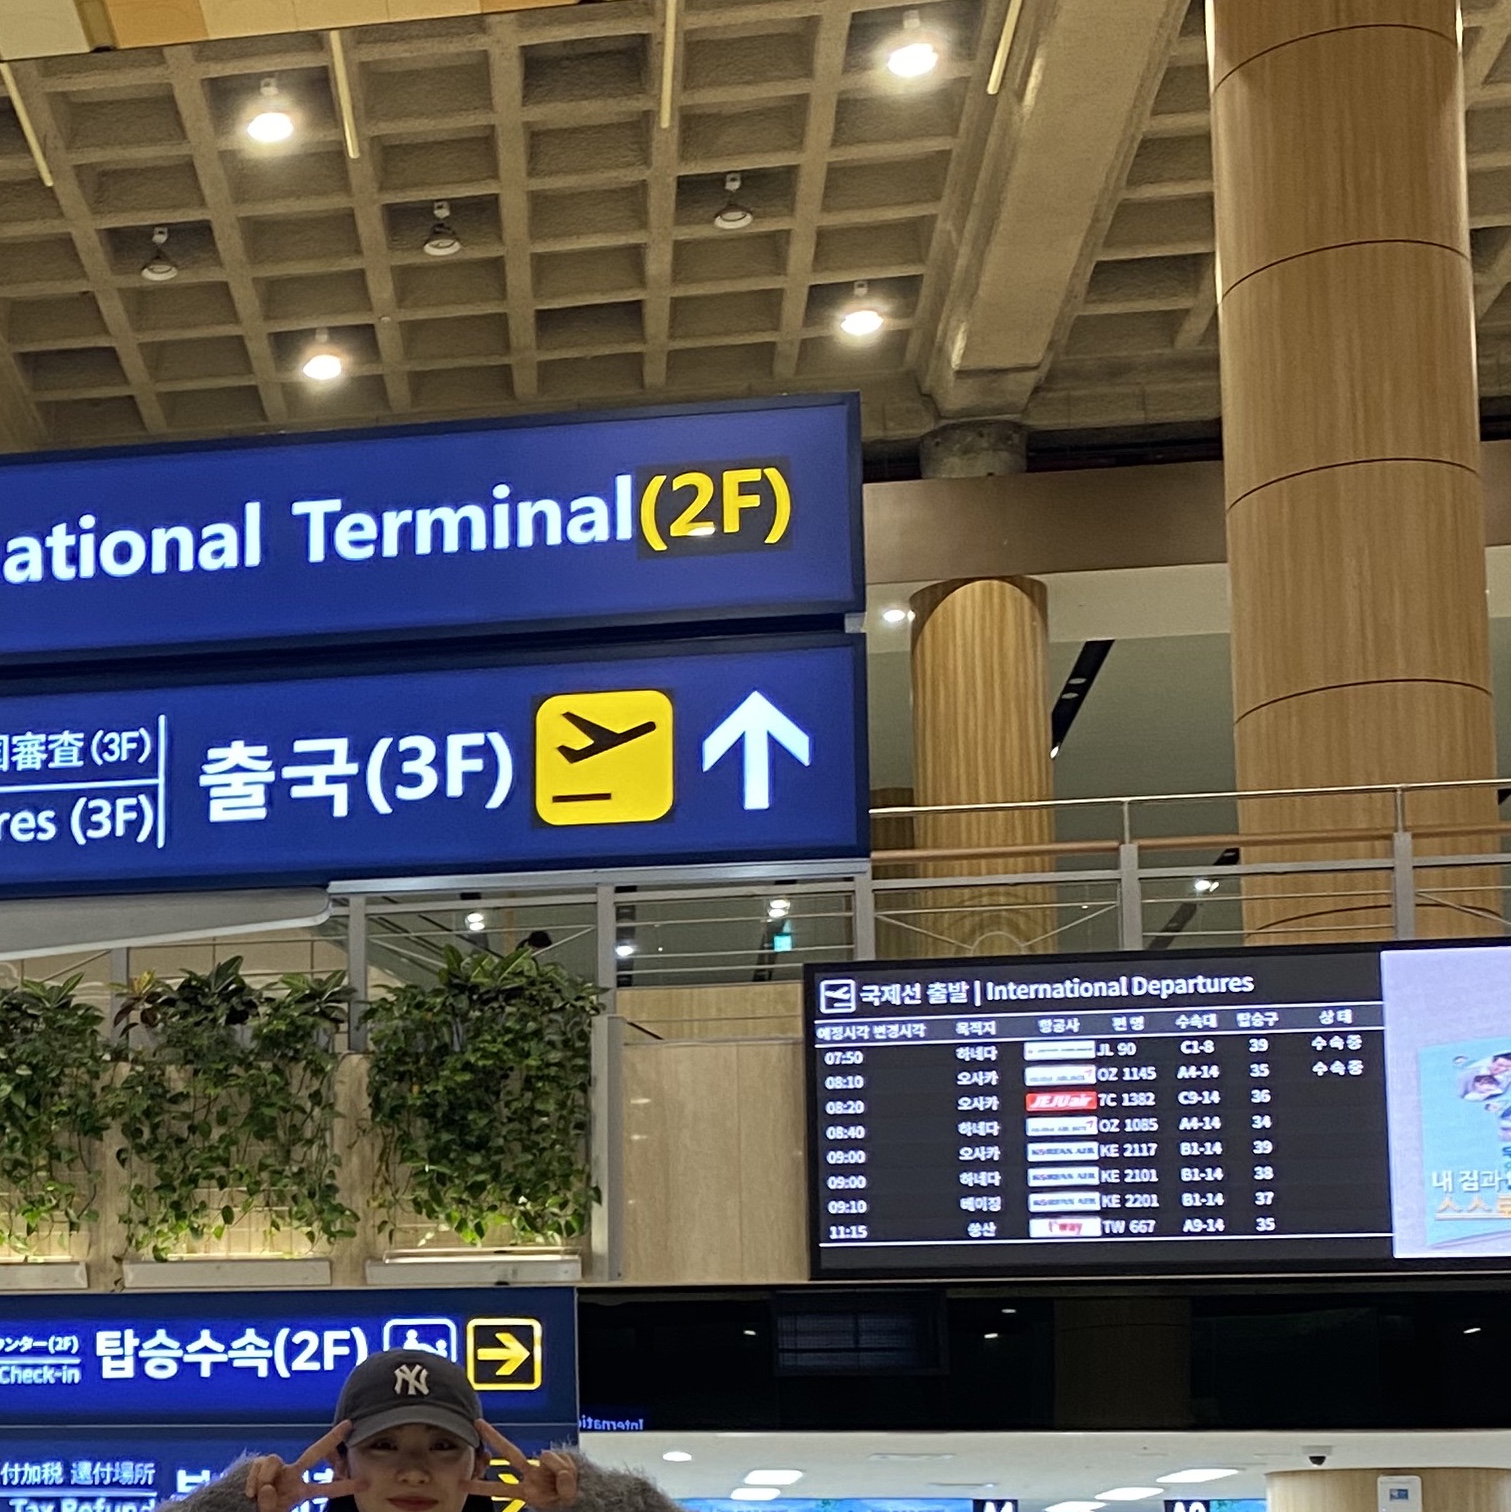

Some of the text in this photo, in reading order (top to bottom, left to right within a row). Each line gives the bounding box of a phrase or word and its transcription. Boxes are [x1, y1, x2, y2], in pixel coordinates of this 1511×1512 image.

[292, 467, 792, 564] Terminal(2F)
[199, 732, 513, 823] 출국(3F)
[70, 795, 154, 845] (3F)
[860, 974, 1254, 1006] 국제선 출발 International Departures
[824, 1051, 863, 1065] 07:50
[1096, 1043, 1114, 1057] JL
[1117, 1042, 1136, 1056] 90
[1248, 1038, 1269, 1053] 39
[824, 1075, 864, 1089] 08:10
[1097, 1068, 1118, 1081] OZ
[1122, 1066, 1156, 1081] 1145
[1249, 1063, 1270, 1078] 35
[825, 1100, 864, 1114] 08:20
[1098, 1093, 1117, 1107] 7C
[1121, 1091, 1155, 1106] 1382
[1250, 1089, 1271, 1103] 36
[825, 1125, 866, 1139] 08:40
[1099, 1118, 1119, 1132] OZ
[1123, 1117, 1159, 1132] 1085
[1252, 1114, 1272, 1129] 34
[826, 1150, 866, 1164] 09:00
[1099, 1143, 1119, 1157] KE
[1123, 1142, 1158, 1157] 2117
[1253, 1140, 1273, 1155] 39
[827, 1175, 867, 1189] 09:00
[1100, 1168, 1120, 1182] KE
[1123, 1168, 1159, 1182] 2101
[1254, 1166, 1274, 1180] 38
[828, 1200, 867, 1214] 09:10
[1101, 1193, 1121, 1207] KE
[1123, 1193, 1159, 1208] 2201
[1255, 1191, 1274, 1206] 37
[829, 1225, 868, 1239] 11:15
[1103, 1219, 1126, 1233] TW
[1129, 1218, 1155, 1233] 667
[1256, 1217, 1276, 1232] 35
[95, 1326, 368, 1380] 탑승수속(2F)
[394, 1365, 429, 1395] NY
